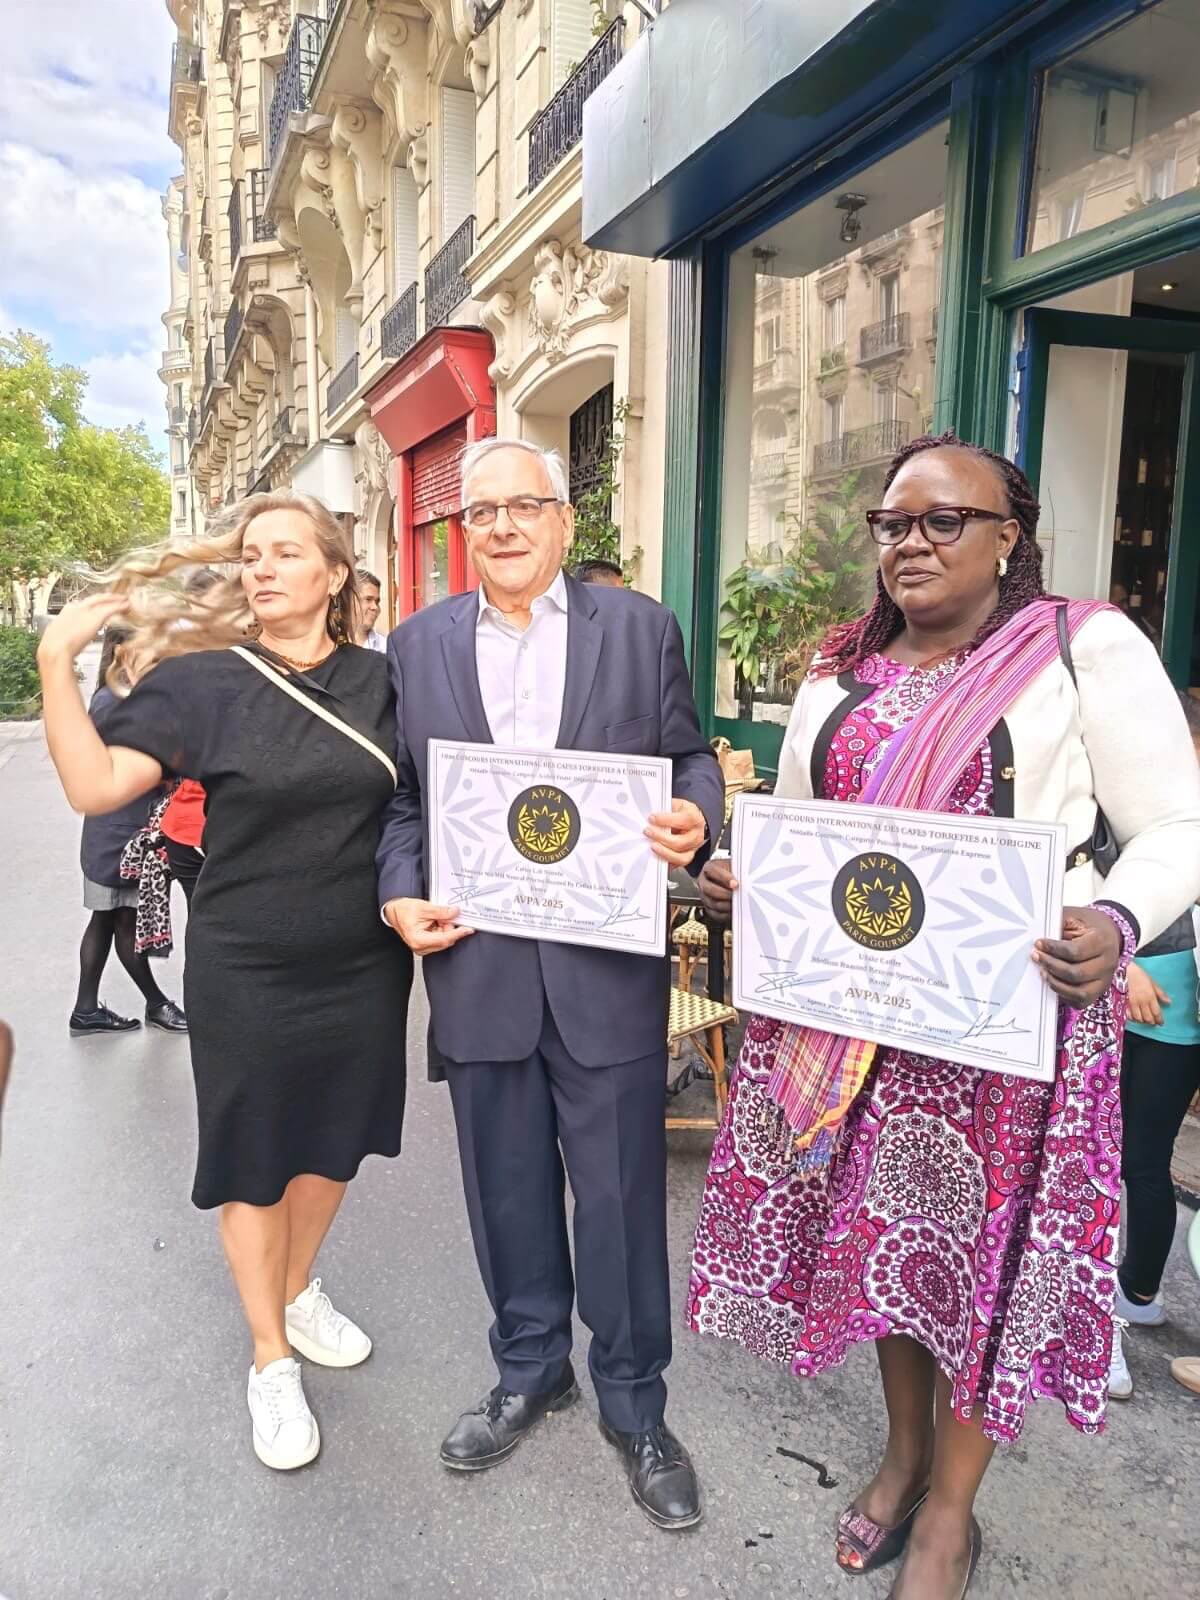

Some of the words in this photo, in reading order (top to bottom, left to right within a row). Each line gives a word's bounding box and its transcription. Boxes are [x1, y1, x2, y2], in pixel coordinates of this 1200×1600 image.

[490, 757, 542, 768] INTERNATIONAL
[531, 789, 562, 804] AVPA
[772, 812, 815, 824] CONCOURS
[816, 817, 881, 831] INTERNATIONAL
[884, 824, 899, 833] DES
[901, 826, 927, 837] CAFES
[930, 830, 979, 843] TORREFIES
[981, 836, 988, 844] A
[990, 837, 1042, 850] L'ORIGINE
[514, 838, 533, 858] PARIS
[533, 846, 570, 863] GOURMET
[860, 857, 897, 875] AVPA
[514, 895, 539, 906] AVPA
[542, 898, 563, 909] 2025
[842, 920, 868, 944] PARIS
[870, 926, 915, 949] GOURMET
[845, 987, 881, 1004] AVPA
[883, 994, 912, 1010] 2025
